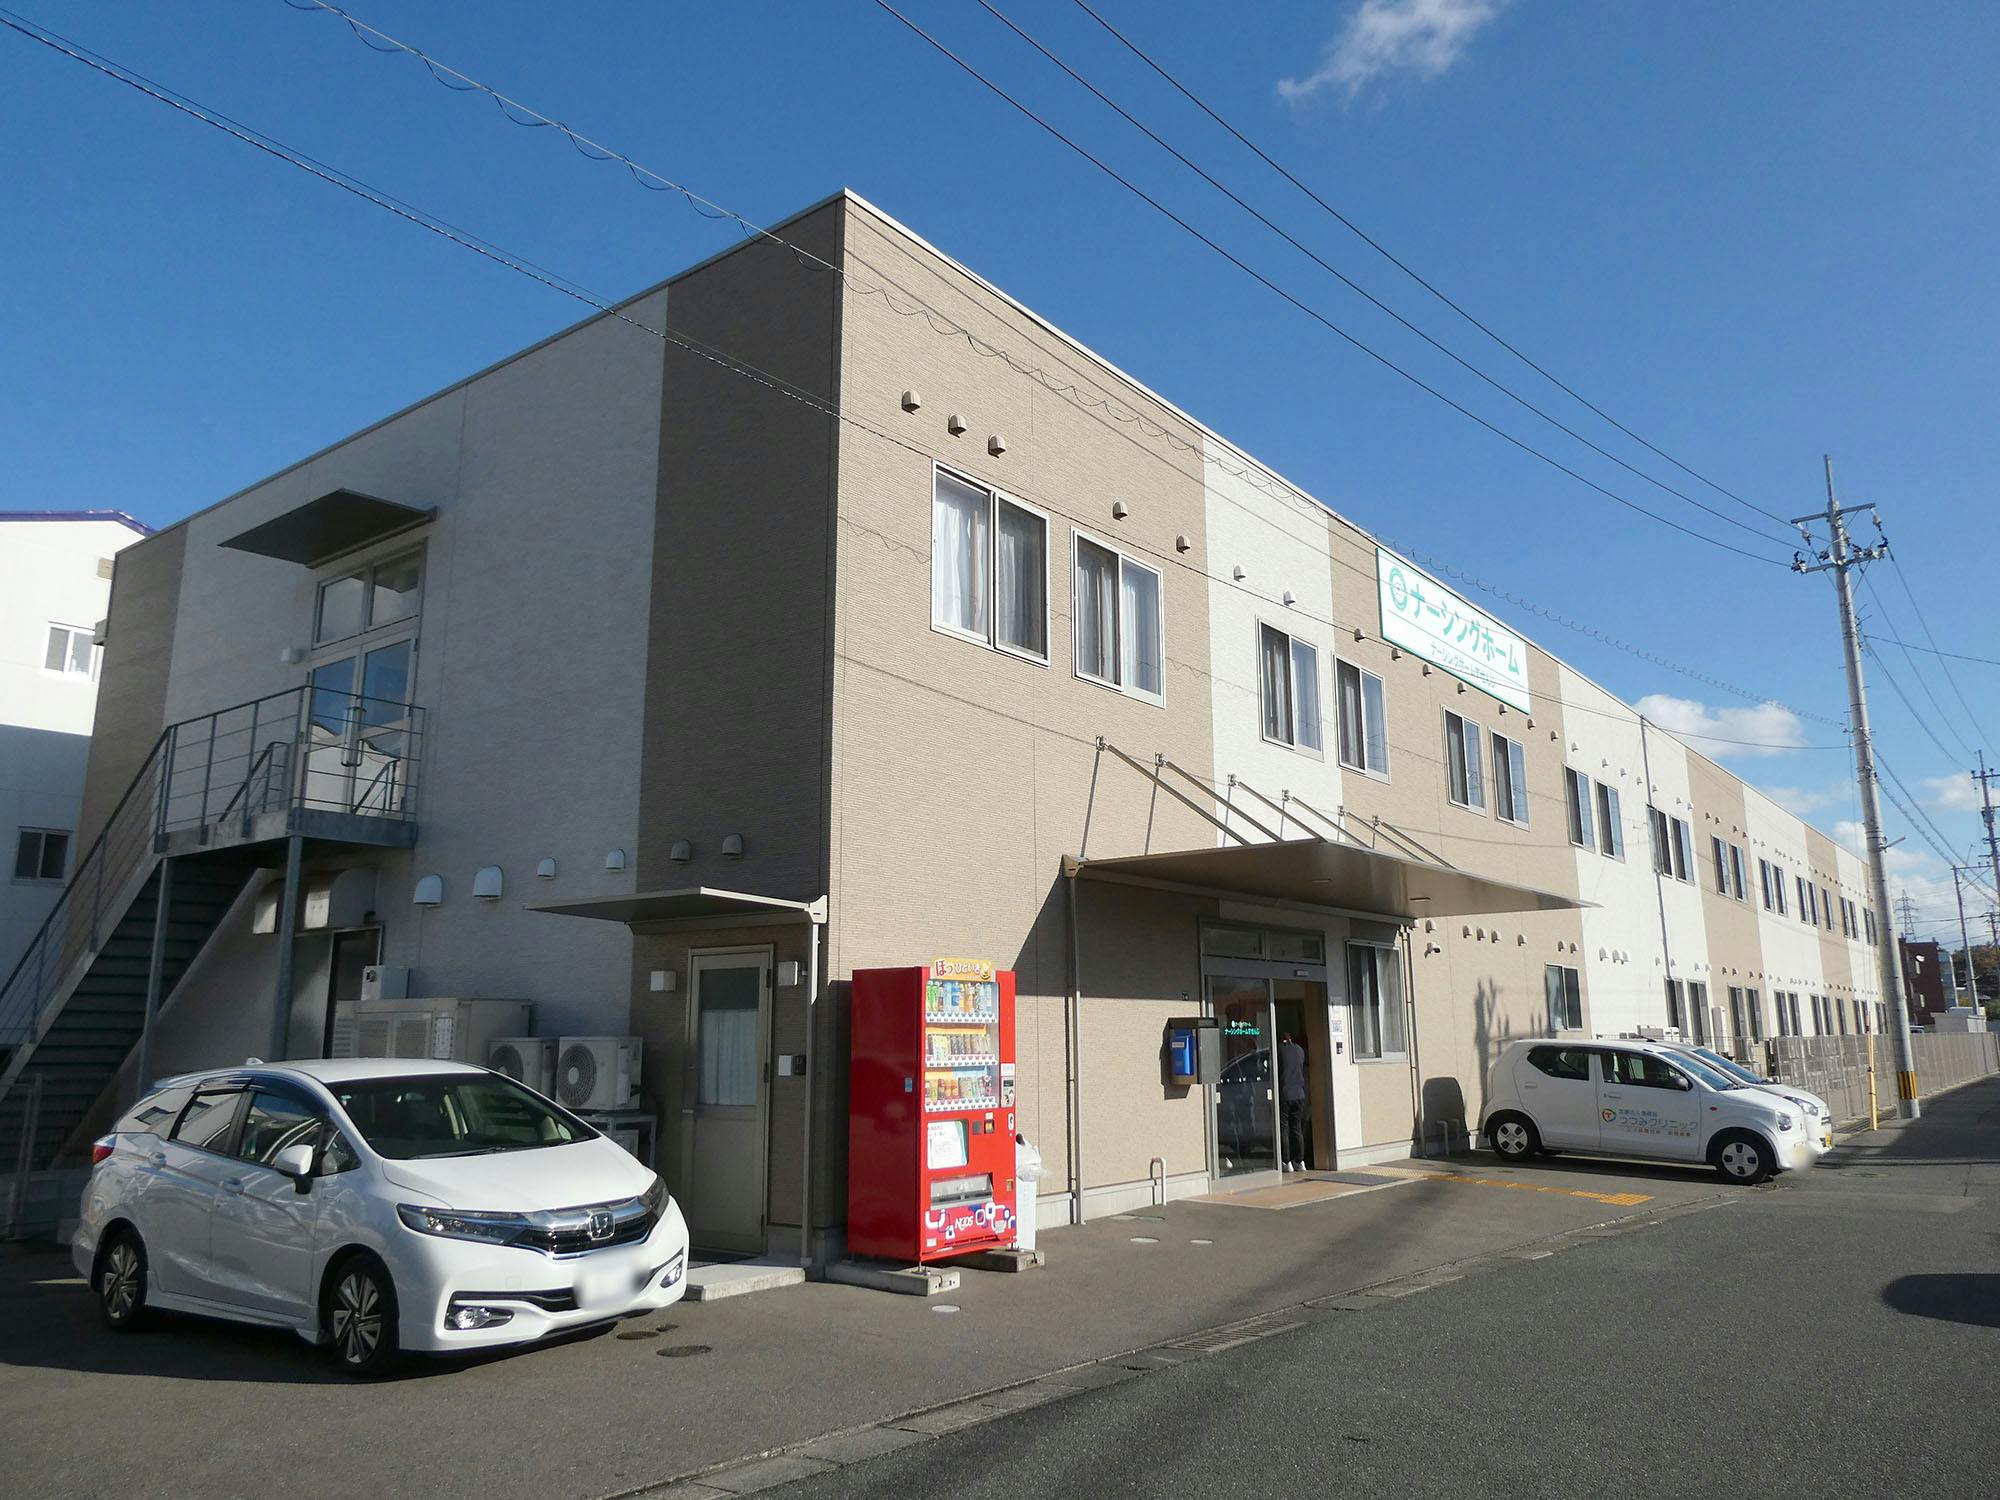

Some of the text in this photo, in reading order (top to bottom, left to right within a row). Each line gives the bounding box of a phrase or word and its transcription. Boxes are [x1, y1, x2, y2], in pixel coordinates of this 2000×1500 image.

[1410, 584, 1519, 676] ナーシングホーム
